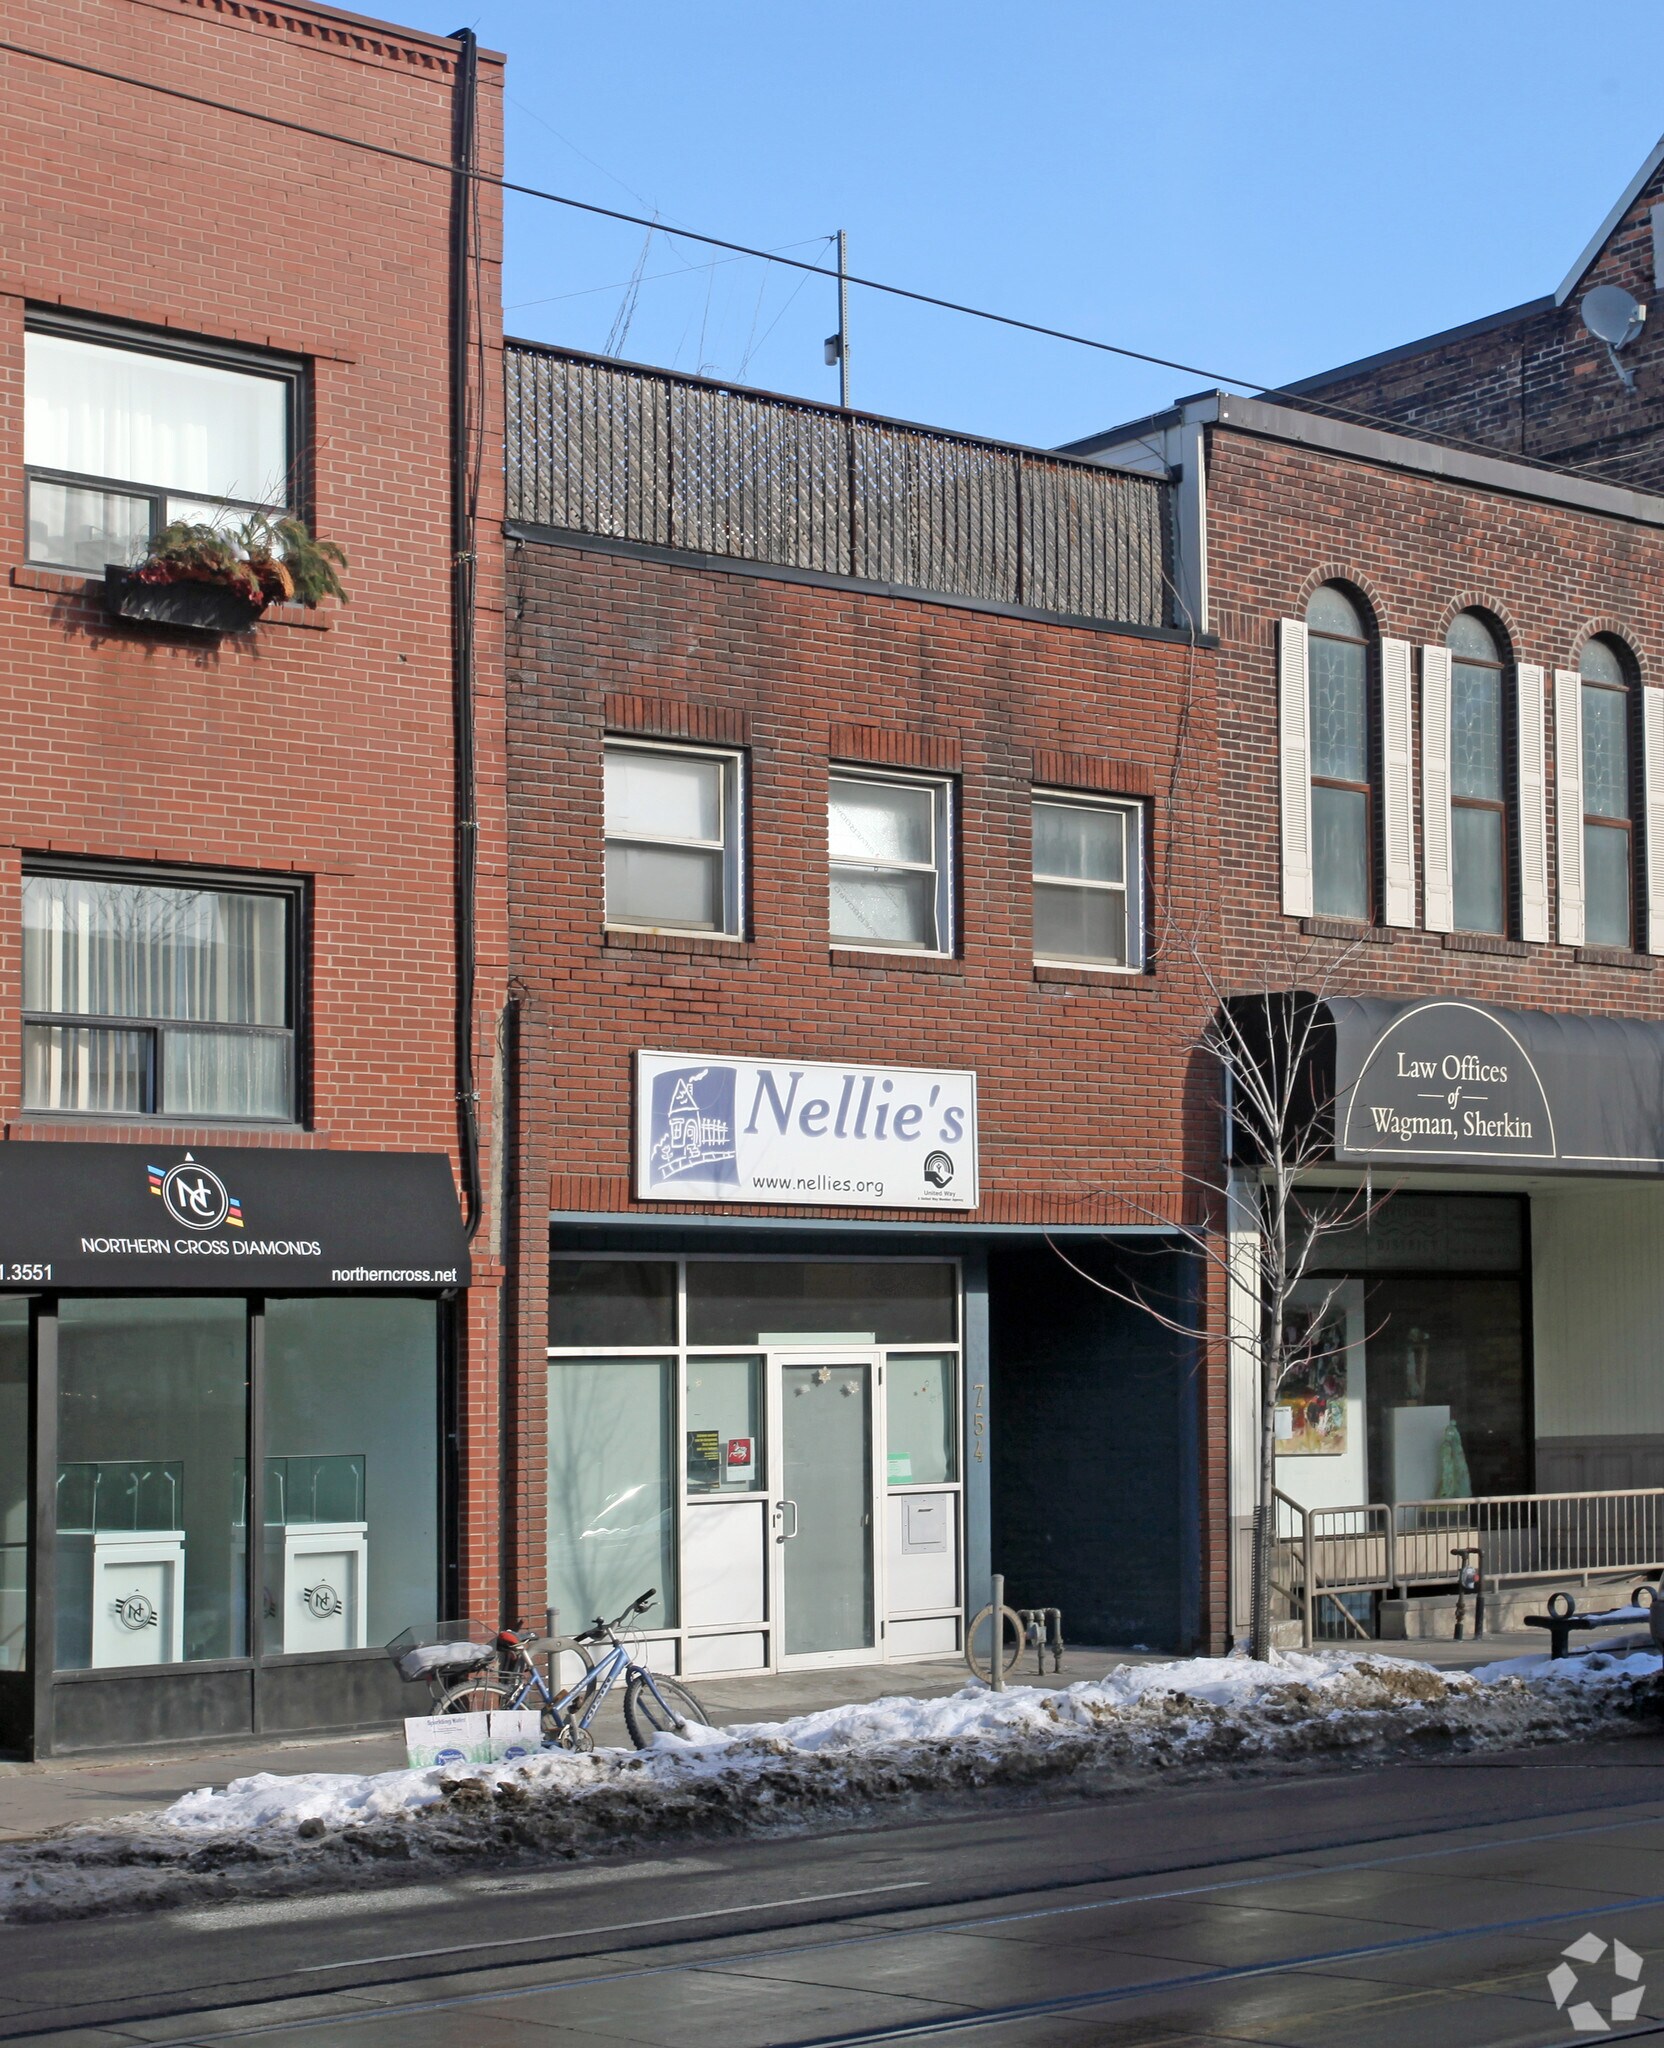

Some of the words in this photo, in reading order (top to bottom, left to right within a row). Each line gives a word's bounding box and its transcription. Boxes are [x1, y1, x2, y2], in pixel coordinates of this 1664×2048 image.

[1397, 1052, 1437, 1079] Law
[1442, 1054, 1508, 1083] Offices
[743, 1069, 965, 1144] Nellie's
[1447, 1086, 1462, 1110] of
[1370, 1106, 1458, 1141] Wagman,
[1463, 1111, 1533, 1139] Sherkin
[752, 1174, 884, 1197] www.nellies.org
[81, 1237, 171, 1255] NORTHERN
[175, 1239, 229, 1256] CROSS
[233, 1240, 321, 1256] DIAMONDS
[332, 1266, 458, 1284] northerncross.net
[972, 1384, 985, 1463] 754
